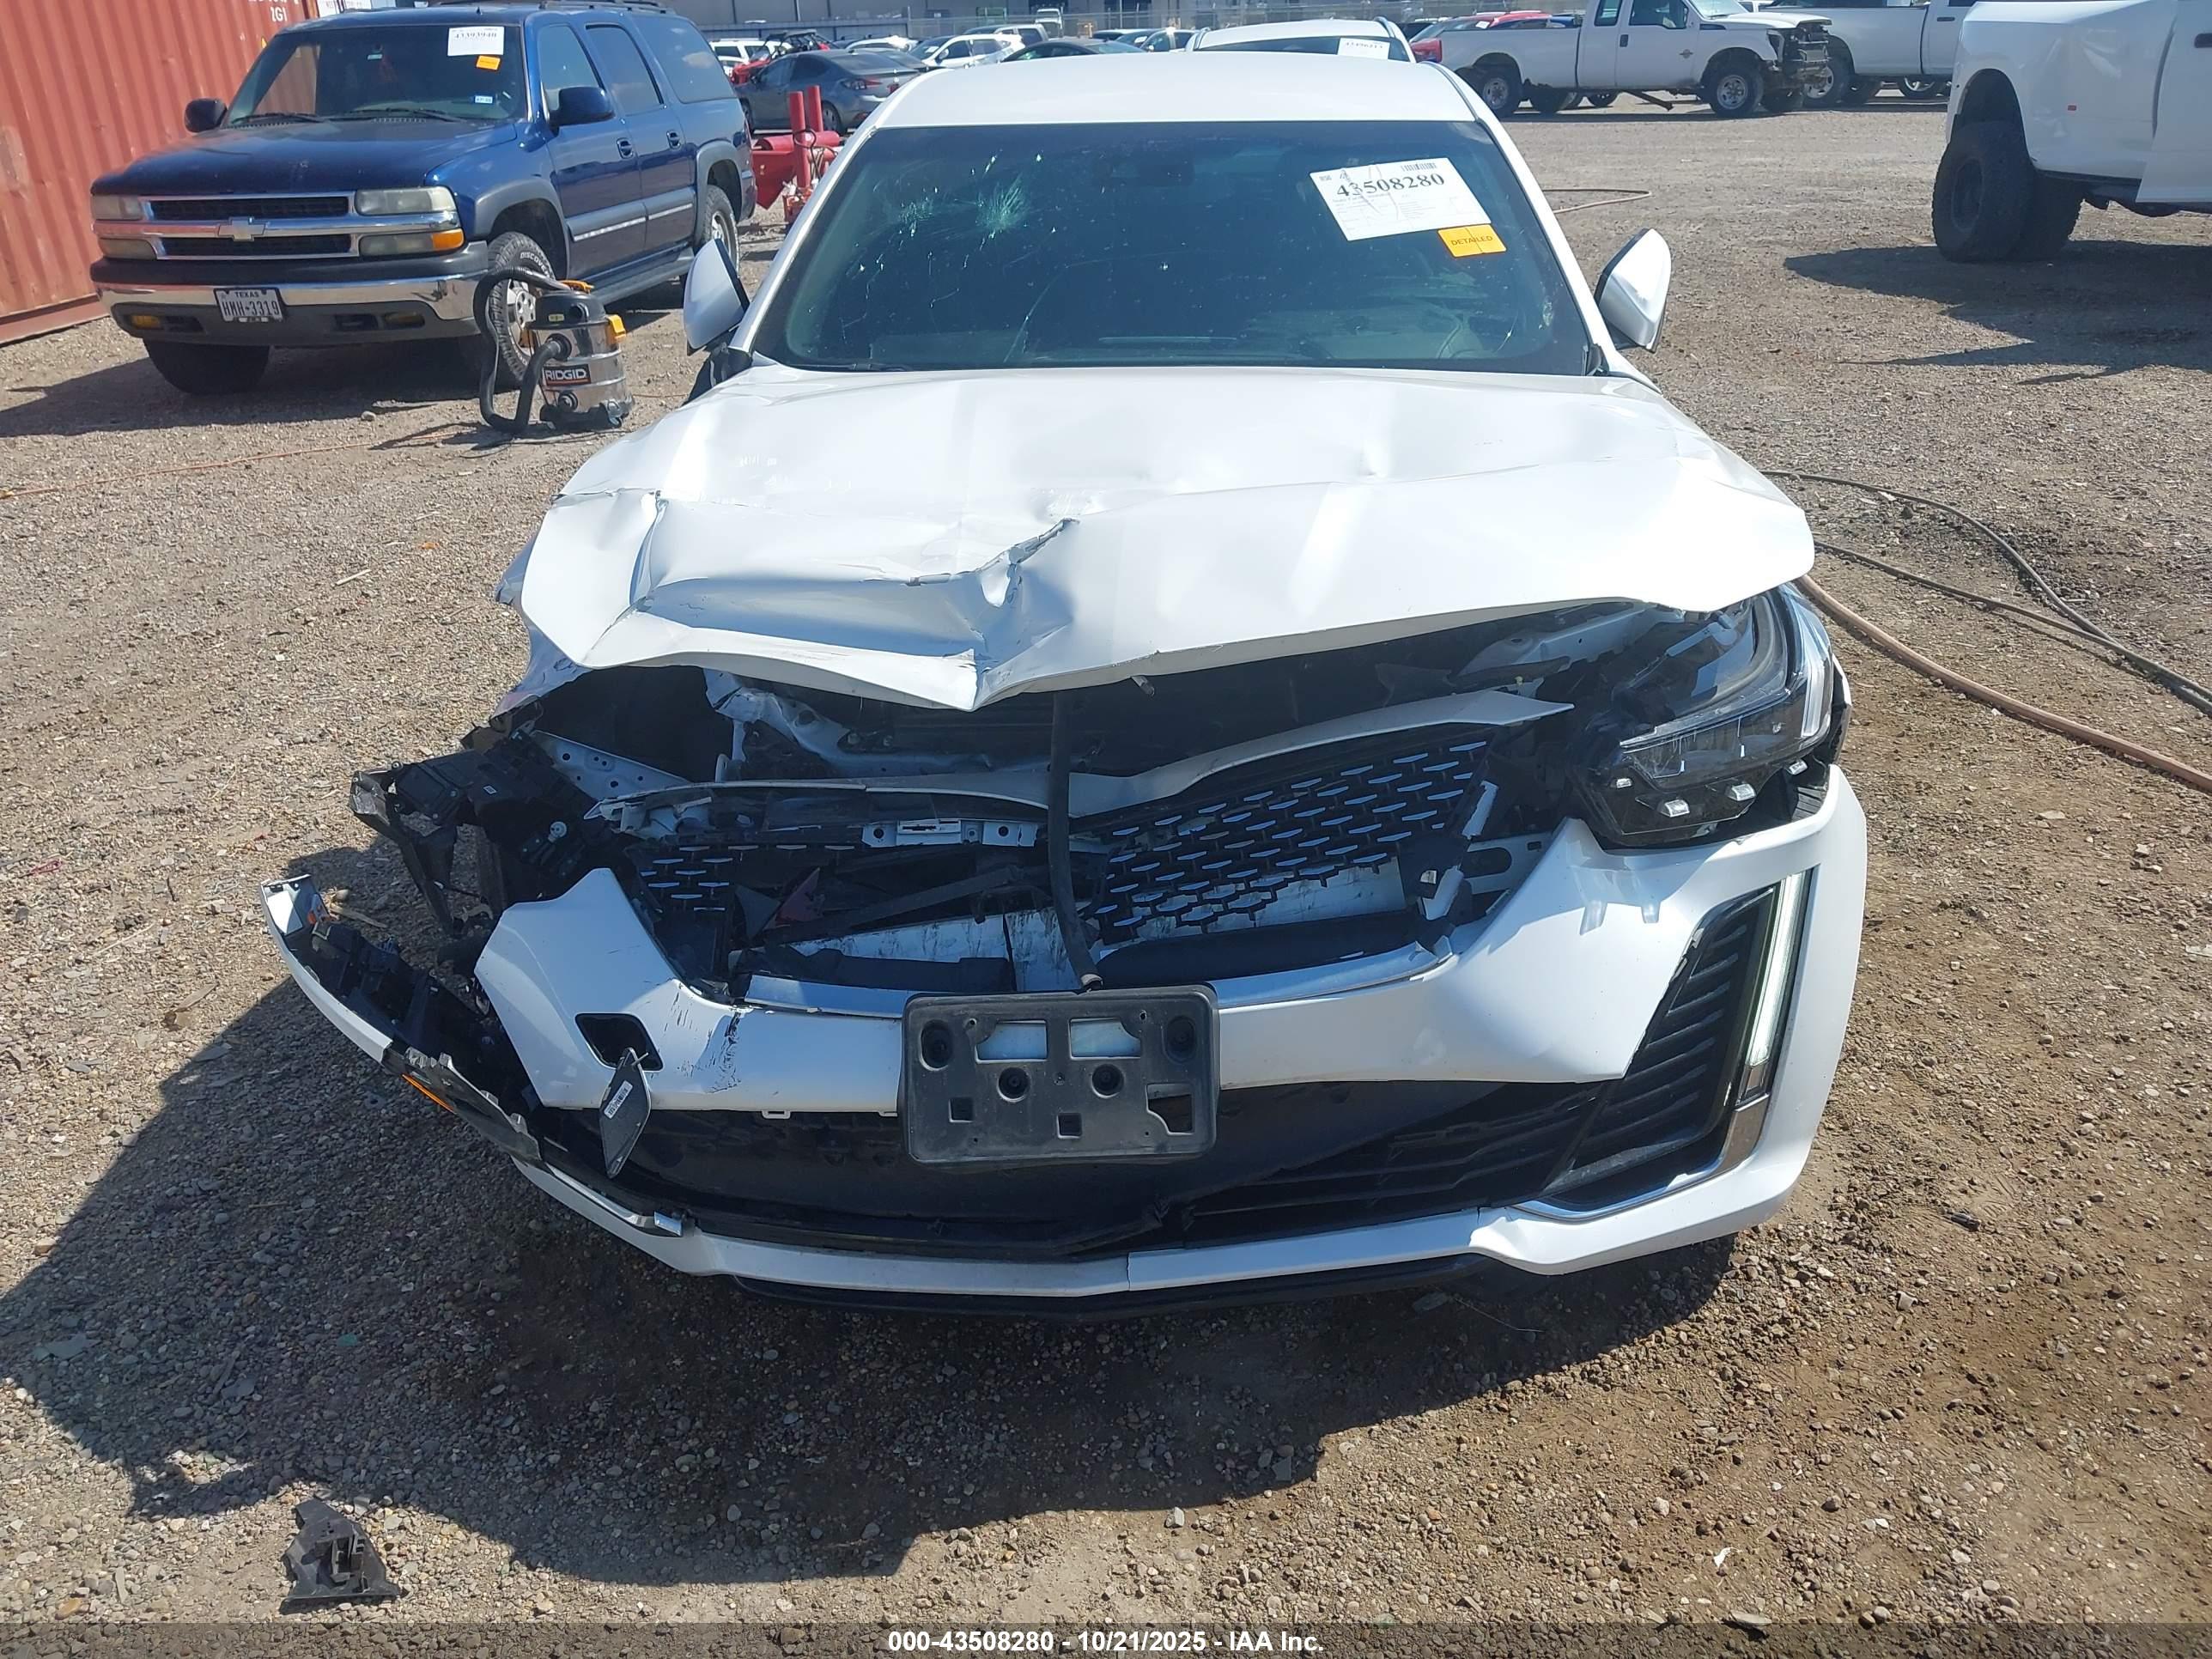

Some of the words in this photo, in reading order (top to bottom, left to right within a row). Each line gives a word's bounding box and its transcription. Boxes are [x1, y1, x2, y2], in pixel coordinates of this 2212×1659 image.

[1337, 173, 1445, 198] 43508280
[1450, 234, 1493, 246] DETAILED
[544, 368, 587, 380] RIDGID
